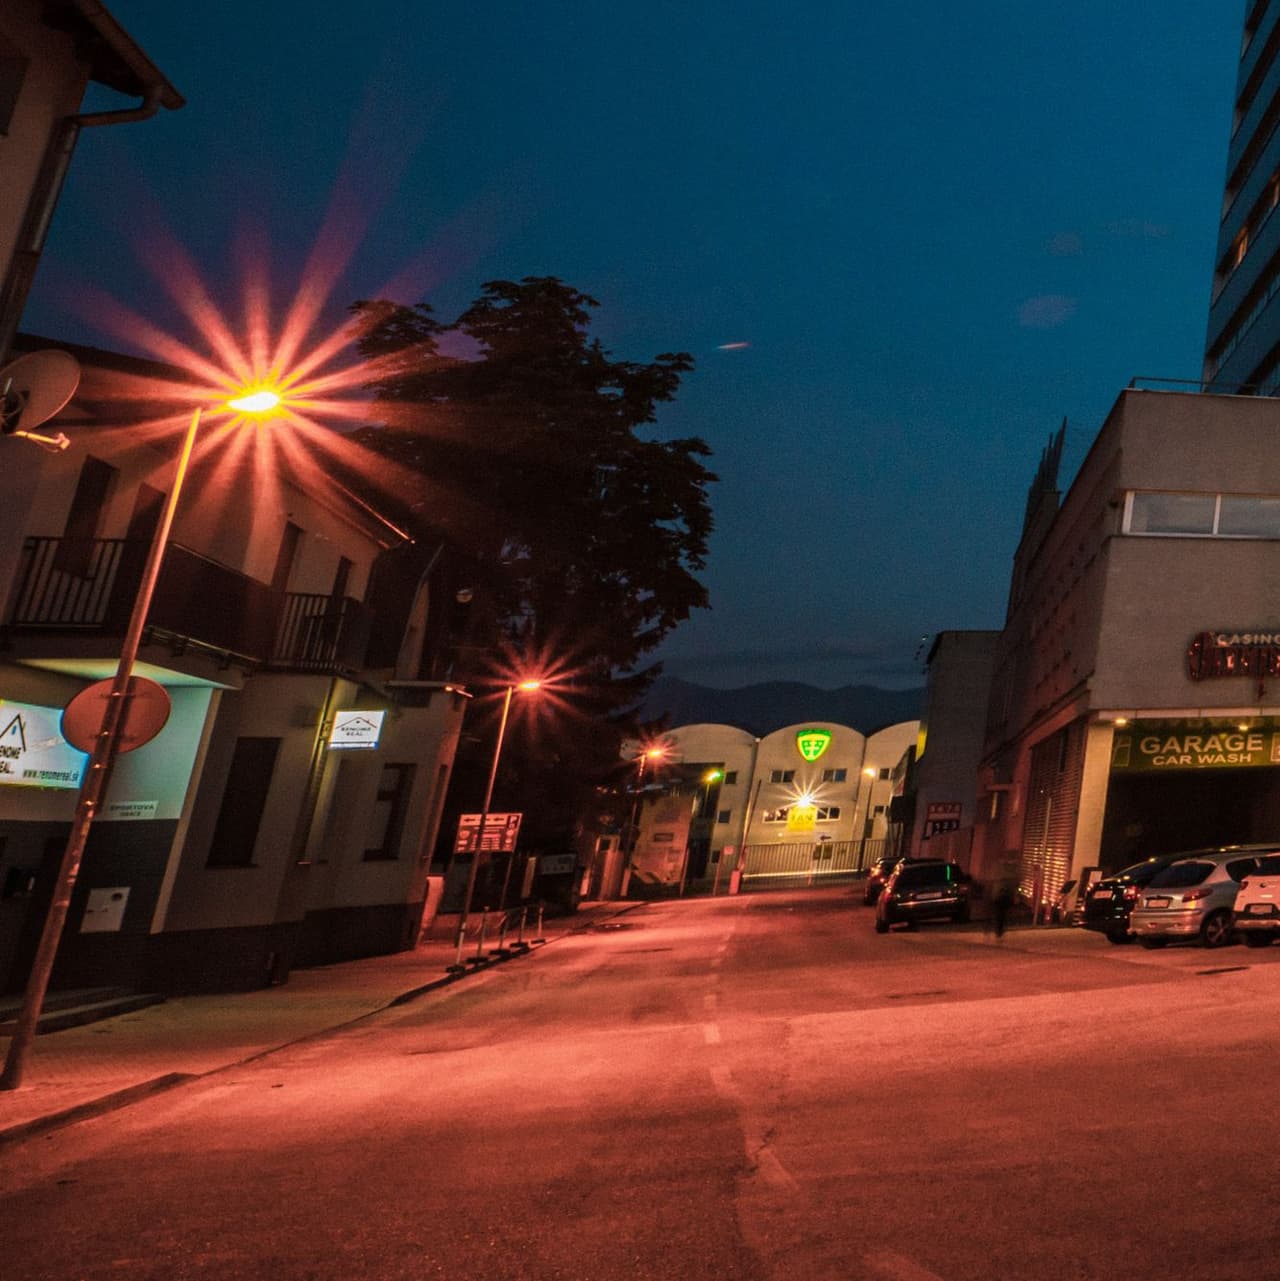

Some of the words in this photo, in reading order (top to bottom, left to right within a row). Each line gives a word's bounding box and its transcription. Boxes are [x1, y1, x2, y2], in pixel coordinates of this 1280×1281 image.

[1140, 733, 1263, 754] GARAGE
[1152, 755, 1192, 766] CAR
[1199, 753, 1252, 764] WASH
